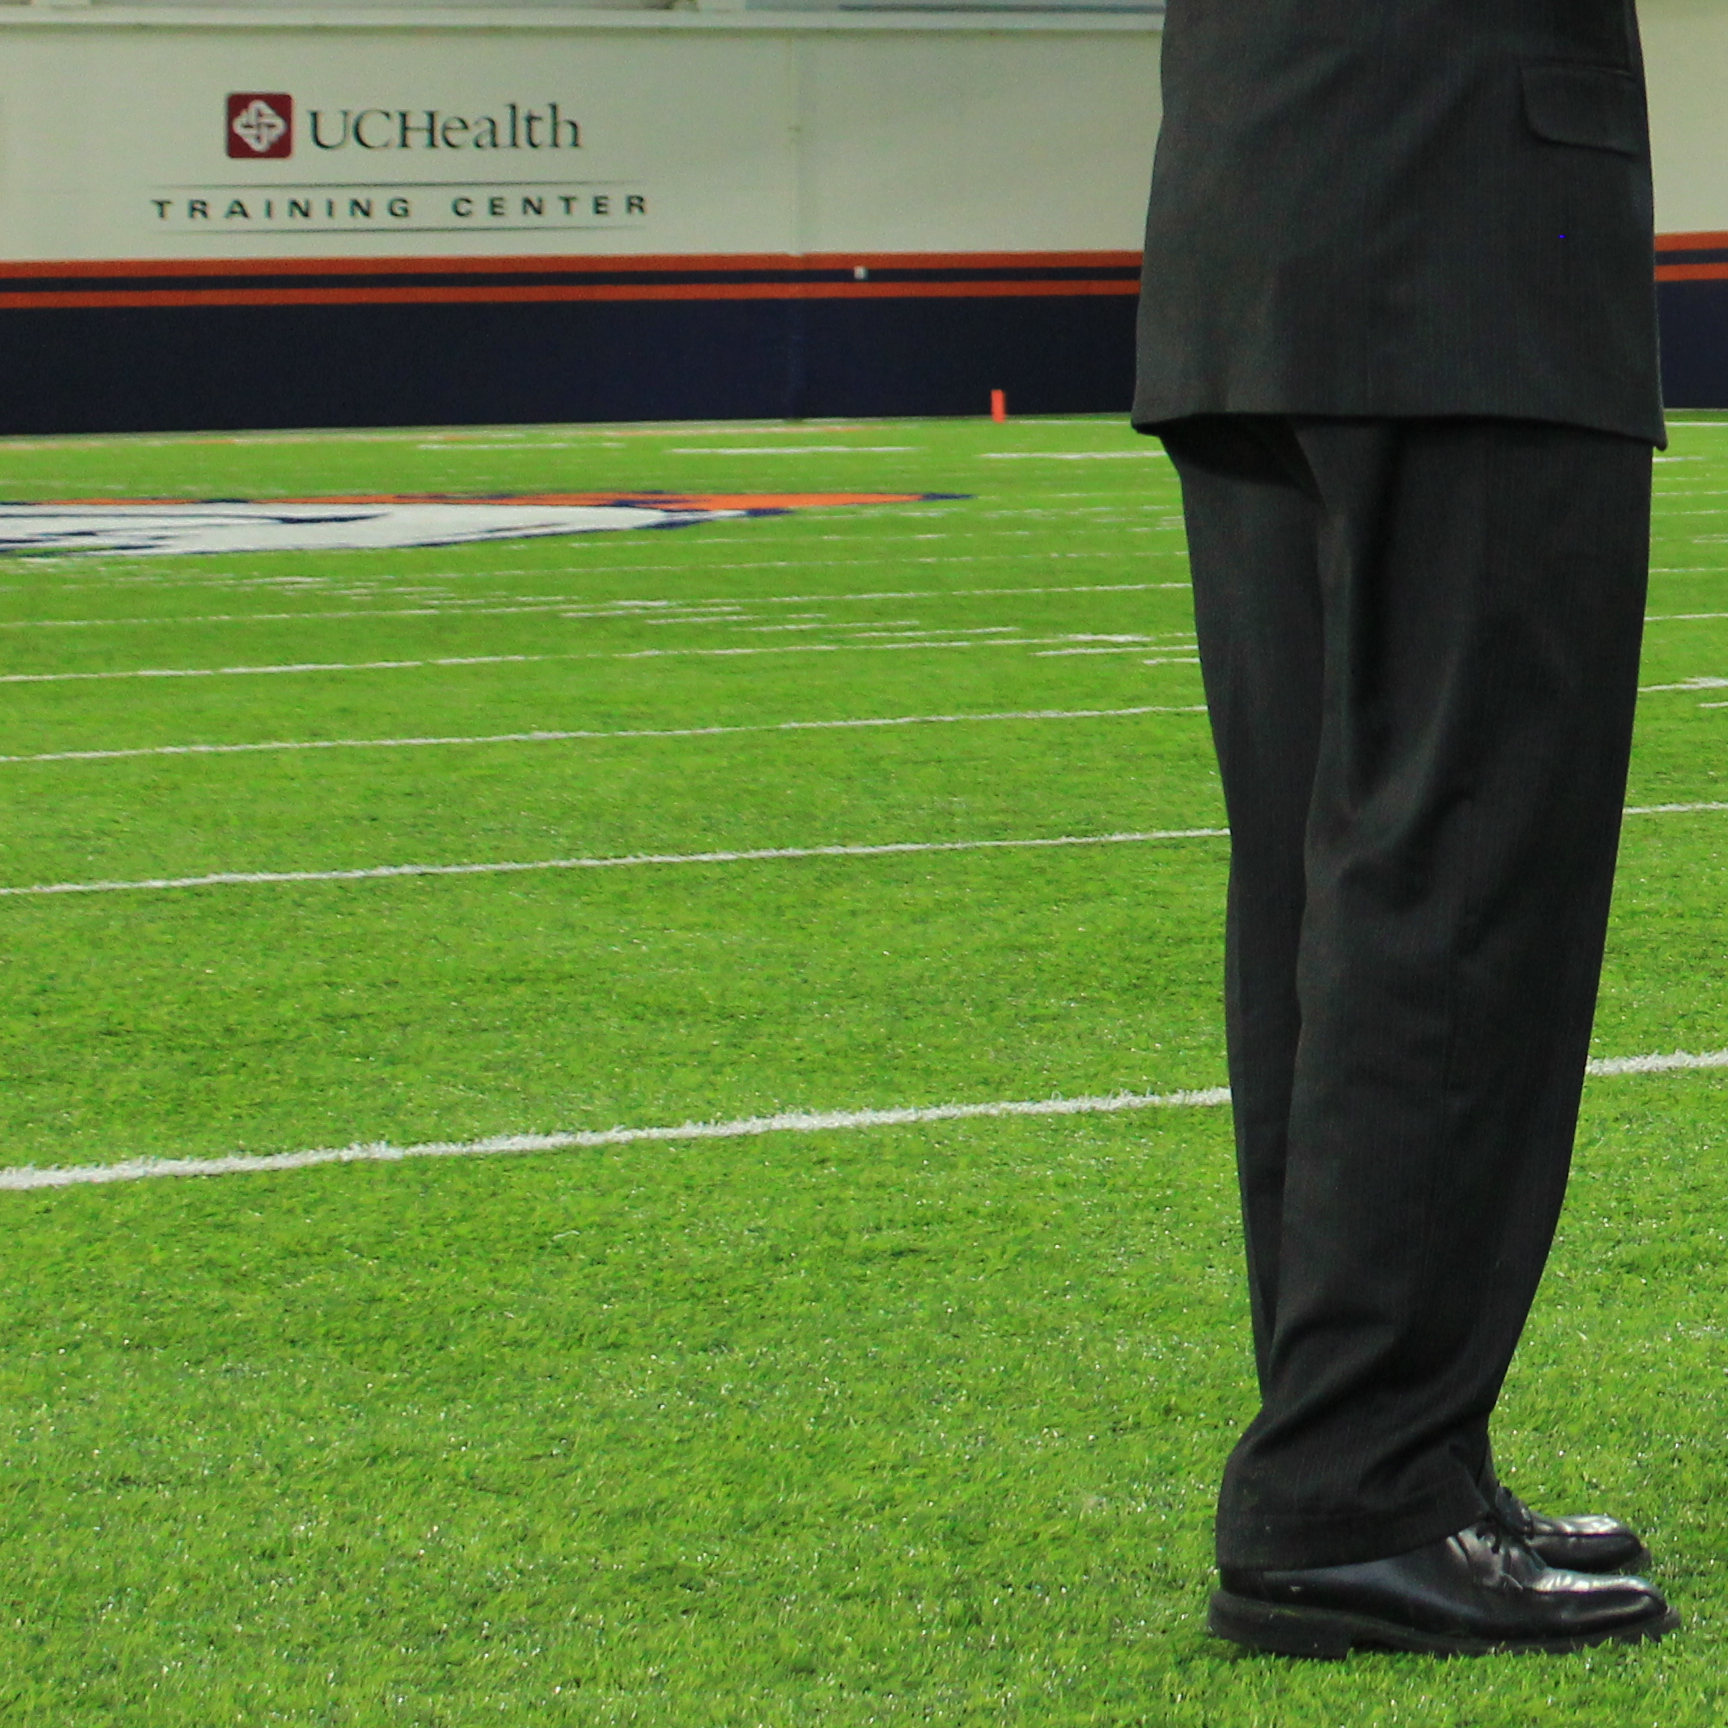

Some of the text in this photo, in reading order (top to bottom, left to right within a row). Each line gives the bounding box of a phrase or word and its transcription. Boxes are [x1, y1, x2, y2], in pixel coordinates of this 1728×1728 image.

[307, 102, 582, 151] UCHealth
[151, 193, 648, 221] TRAINING CENTER
